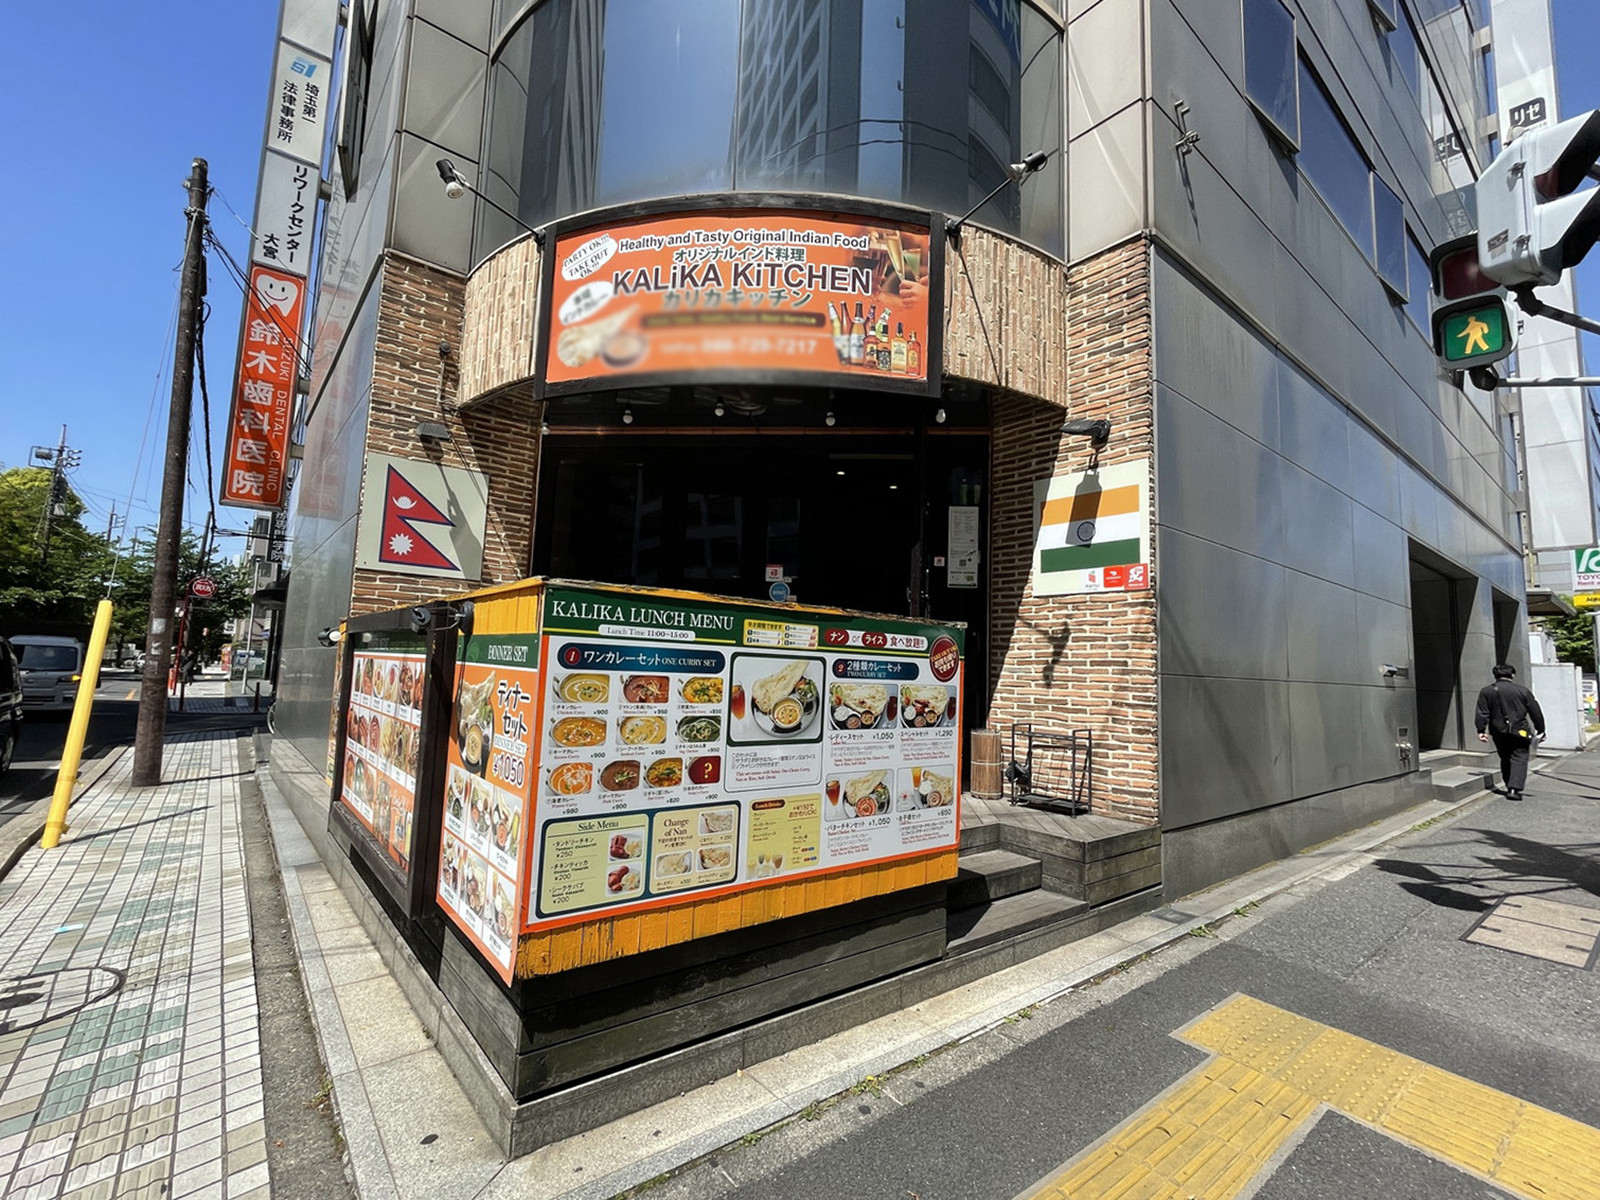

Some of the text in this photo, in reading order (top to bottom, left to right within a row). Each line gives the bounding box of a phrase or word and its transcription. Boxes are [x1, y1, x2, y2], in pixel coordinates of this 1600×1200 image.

[277, 80, 298, 144] 法律事務所
[301, 82, 320, 125] 埼玉第一
[1514, 103, 1540, 125] リゼ
[286, 165, 307, 263] リワークセンター
[262, 233, 280, 259] 大宮
[620, 229, 868, 253] Healthy and Tasty Original Indian Food
[563, 247, 588, 268] PARTY
[569, 248, 608, 276] TAKE OUT
[674, 246, 805, 263] オリジナルインド料理
[664, 288, 812, 309] カリカキッチン
[231, 319, 281, 496] 鈴木歯科医院
[272, 391, 288, 439] DENTAL
[267, 450, 281, 491] CLINIC
[552, 600, 735, 630] KALIKA LUNCH MENU
[607, 627, 628, 635] Lunch
[629, 628, 646, 637] Time
[830, 632, 845, 641] ナン
[852, 635, 860, 643] or
[865, 635, 884, 645] ライス
[584, 651, 661, 666] ワンカレーセット
[661, 657, 678, 666] ONE
[678, 658, 703, 667] CURRY
[703, 659, 717, 667] SET
[847, 661, 901, 672] 2種類カレーセット
[503, 710, 527, 740] セット
[493, 754, 525, 787] ¥1050
[578, 820, 619, 831] Side Menu
[664, 819, 690, 828] Change
[664, 828, 687, 837] of Nan
